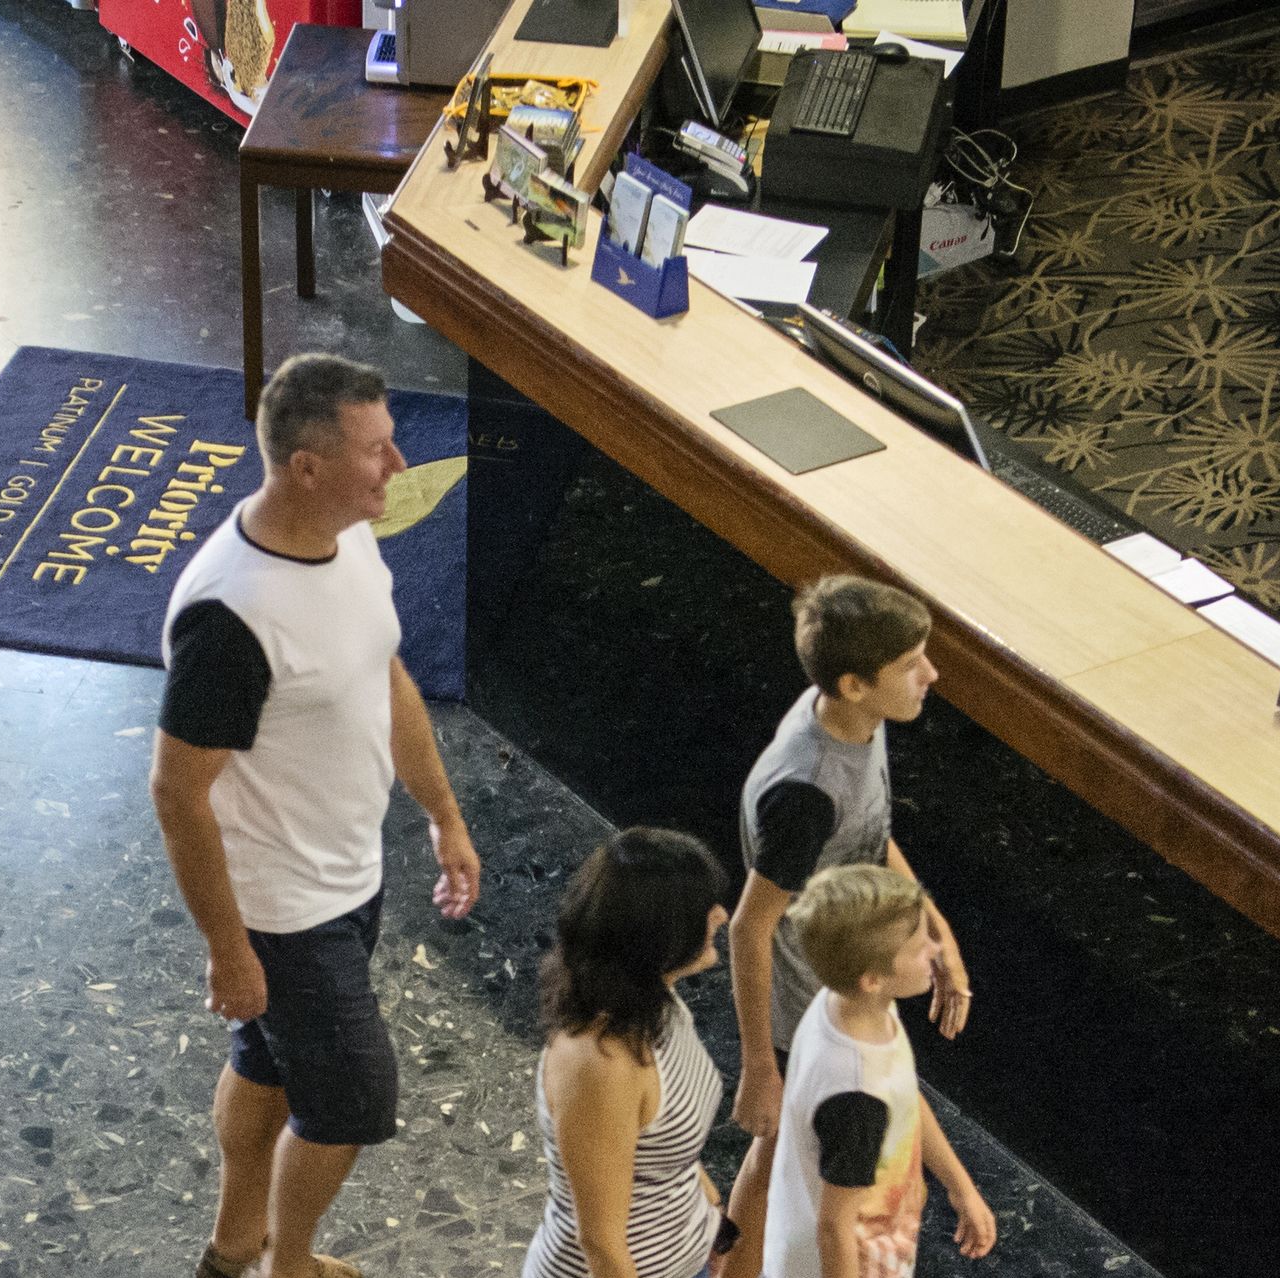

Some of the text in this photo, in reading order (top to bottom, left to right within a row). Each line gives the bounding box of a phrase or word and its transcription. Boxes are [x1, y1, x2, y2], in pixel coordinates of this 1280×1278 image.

[929, 234, 968, 252] Canon
[34, 377, 103, 452] PLATINUM
[32, 414, 187, 585] WELCOME
[106, 439, 247, 573] Priority
